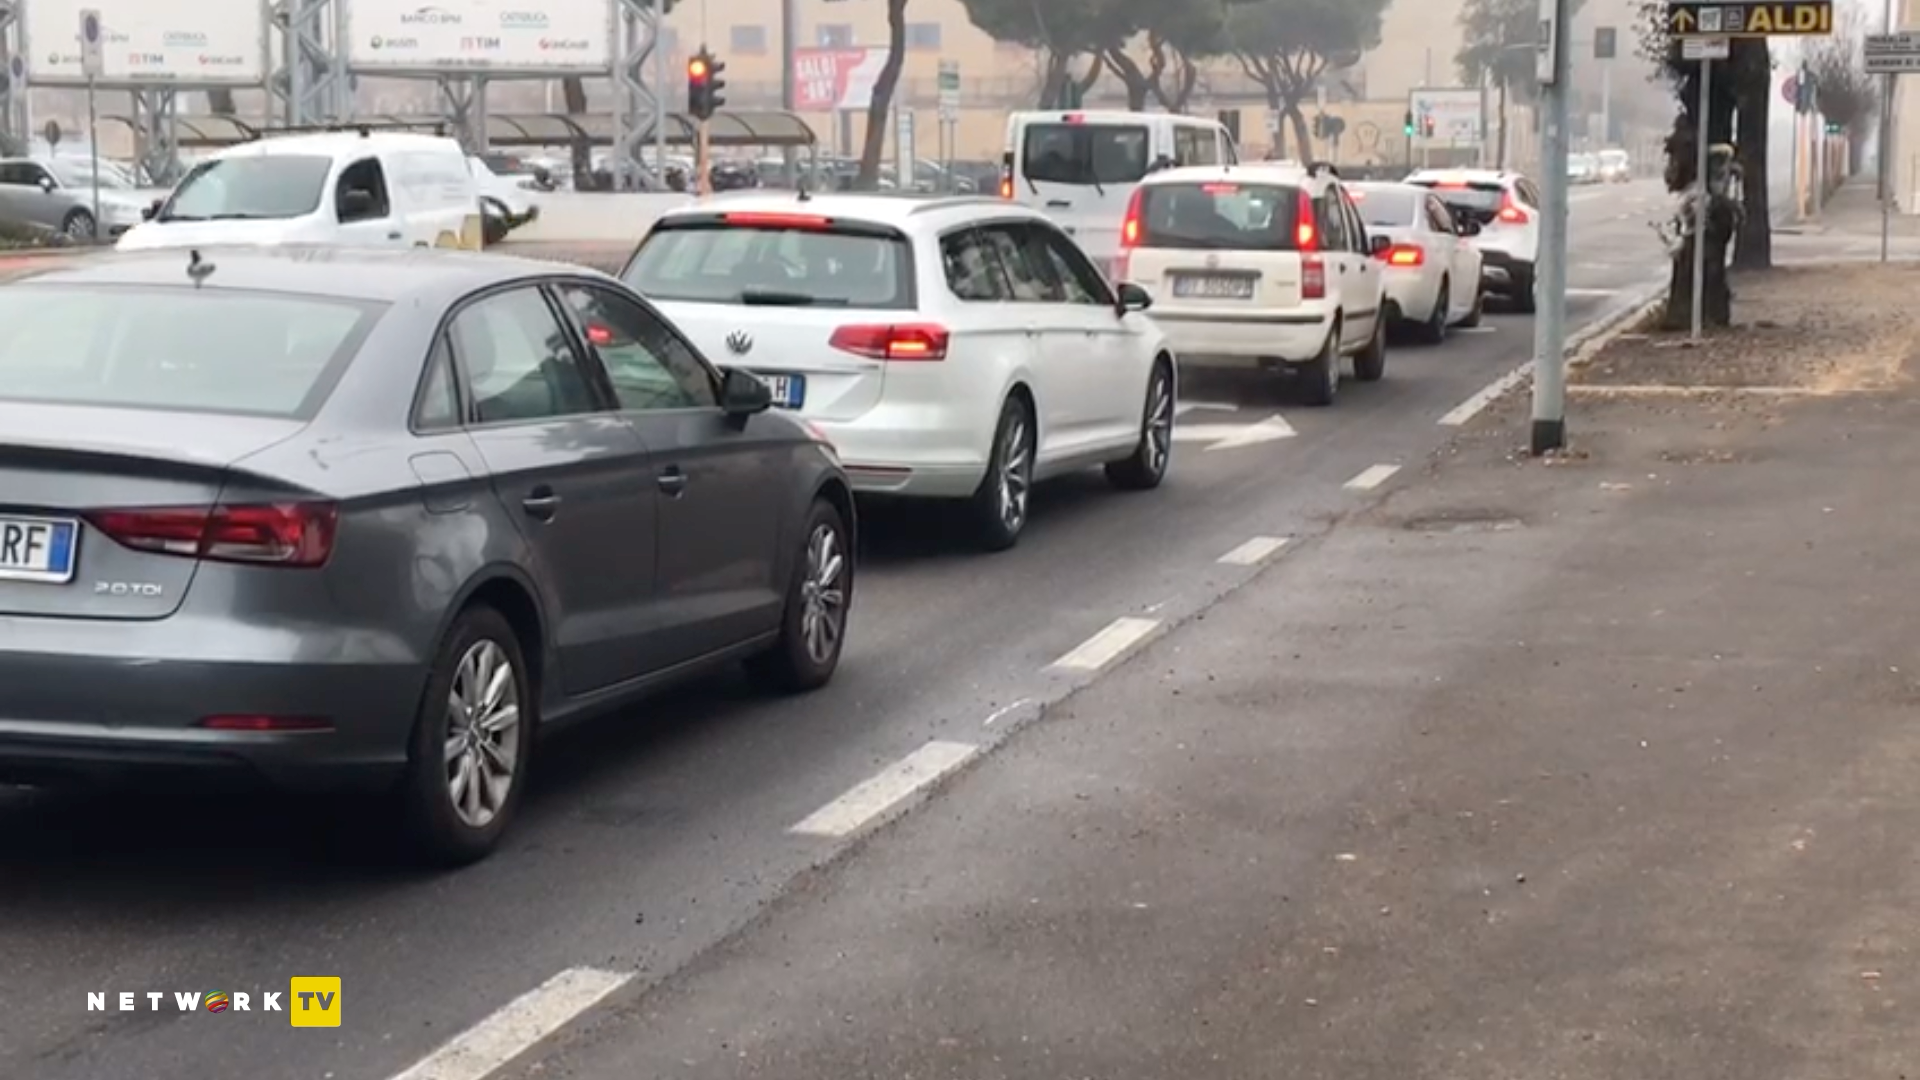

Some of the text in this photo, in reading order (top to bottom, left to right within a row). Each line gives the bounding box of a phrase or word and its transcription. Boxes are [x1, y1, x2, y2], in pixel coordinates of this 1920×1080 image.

[401, 14, 437, 24] BANCO
[1747, 4, 1830, 32] ALDI
[476, 36, 501, 48] TIM
[142, 53, 164, 64] TIM
[130, 583, 162, 596] TDI
